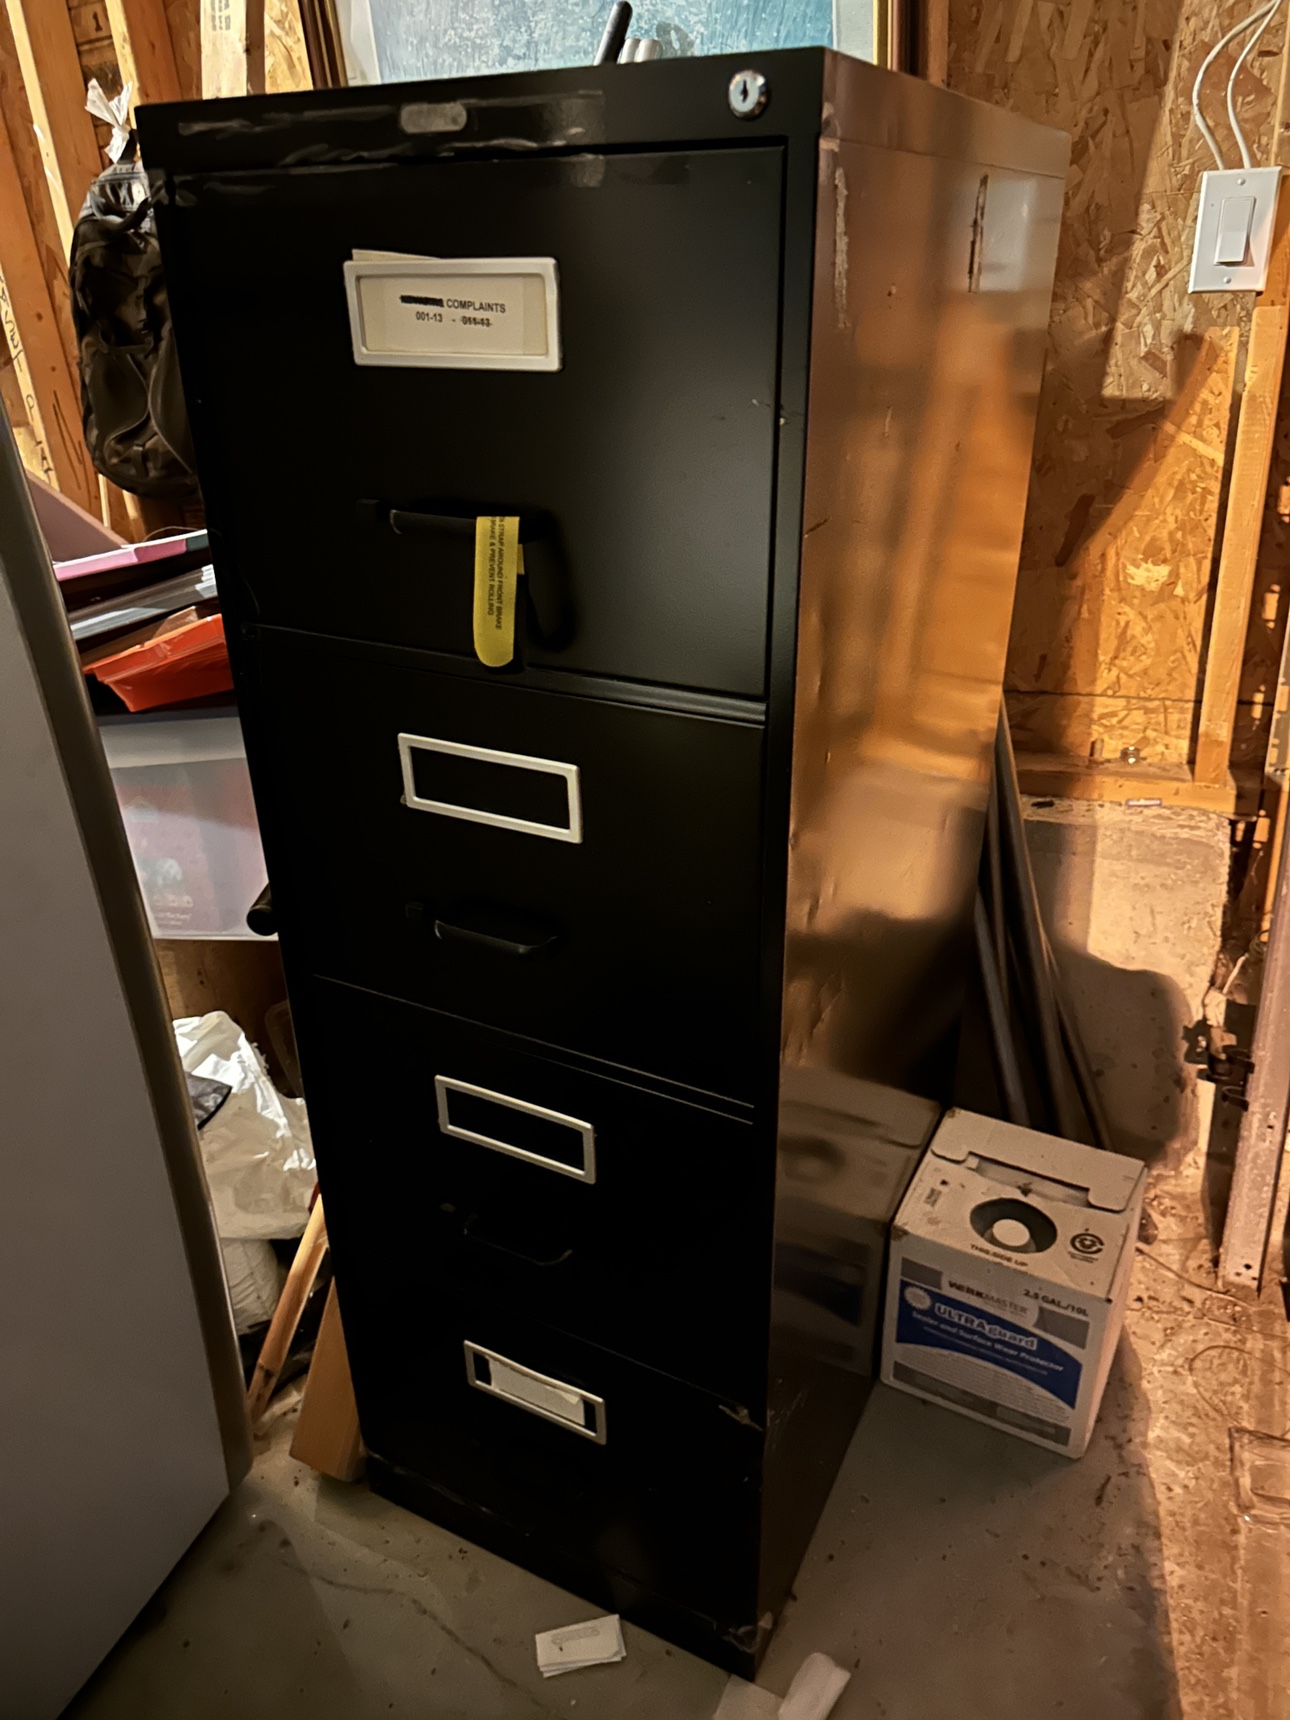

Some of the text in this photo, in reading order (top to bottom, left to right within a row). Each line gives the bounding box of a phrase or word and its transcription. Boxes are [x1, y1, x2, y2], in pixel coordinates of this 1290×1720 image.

[415, 311, 443, 323] 001-13
[446, 298, 506, 313] COMPLAINTS
[488, 548, 496, 582] PREVENT
[487, 583, 495, 616] ROLLING
[495, 605, 503, 630] BRAKE
[992, 1251, 1013, 1263] SIDE
[1014, 1258, 1029, 1268] UP
[948, 1280, 1029, 1314] WERKMASTER
[1023, 1288, 1040, 1300] 2.5
[935, 1302, 1037, 1350] ULTRAguard
[939, 1322, 958, 1334] and
[958, 1327, 993, 1347] Surface
[993, 1341, 1019, 1356] Wear
[1019, 1350, 1065, 1372] Protector
